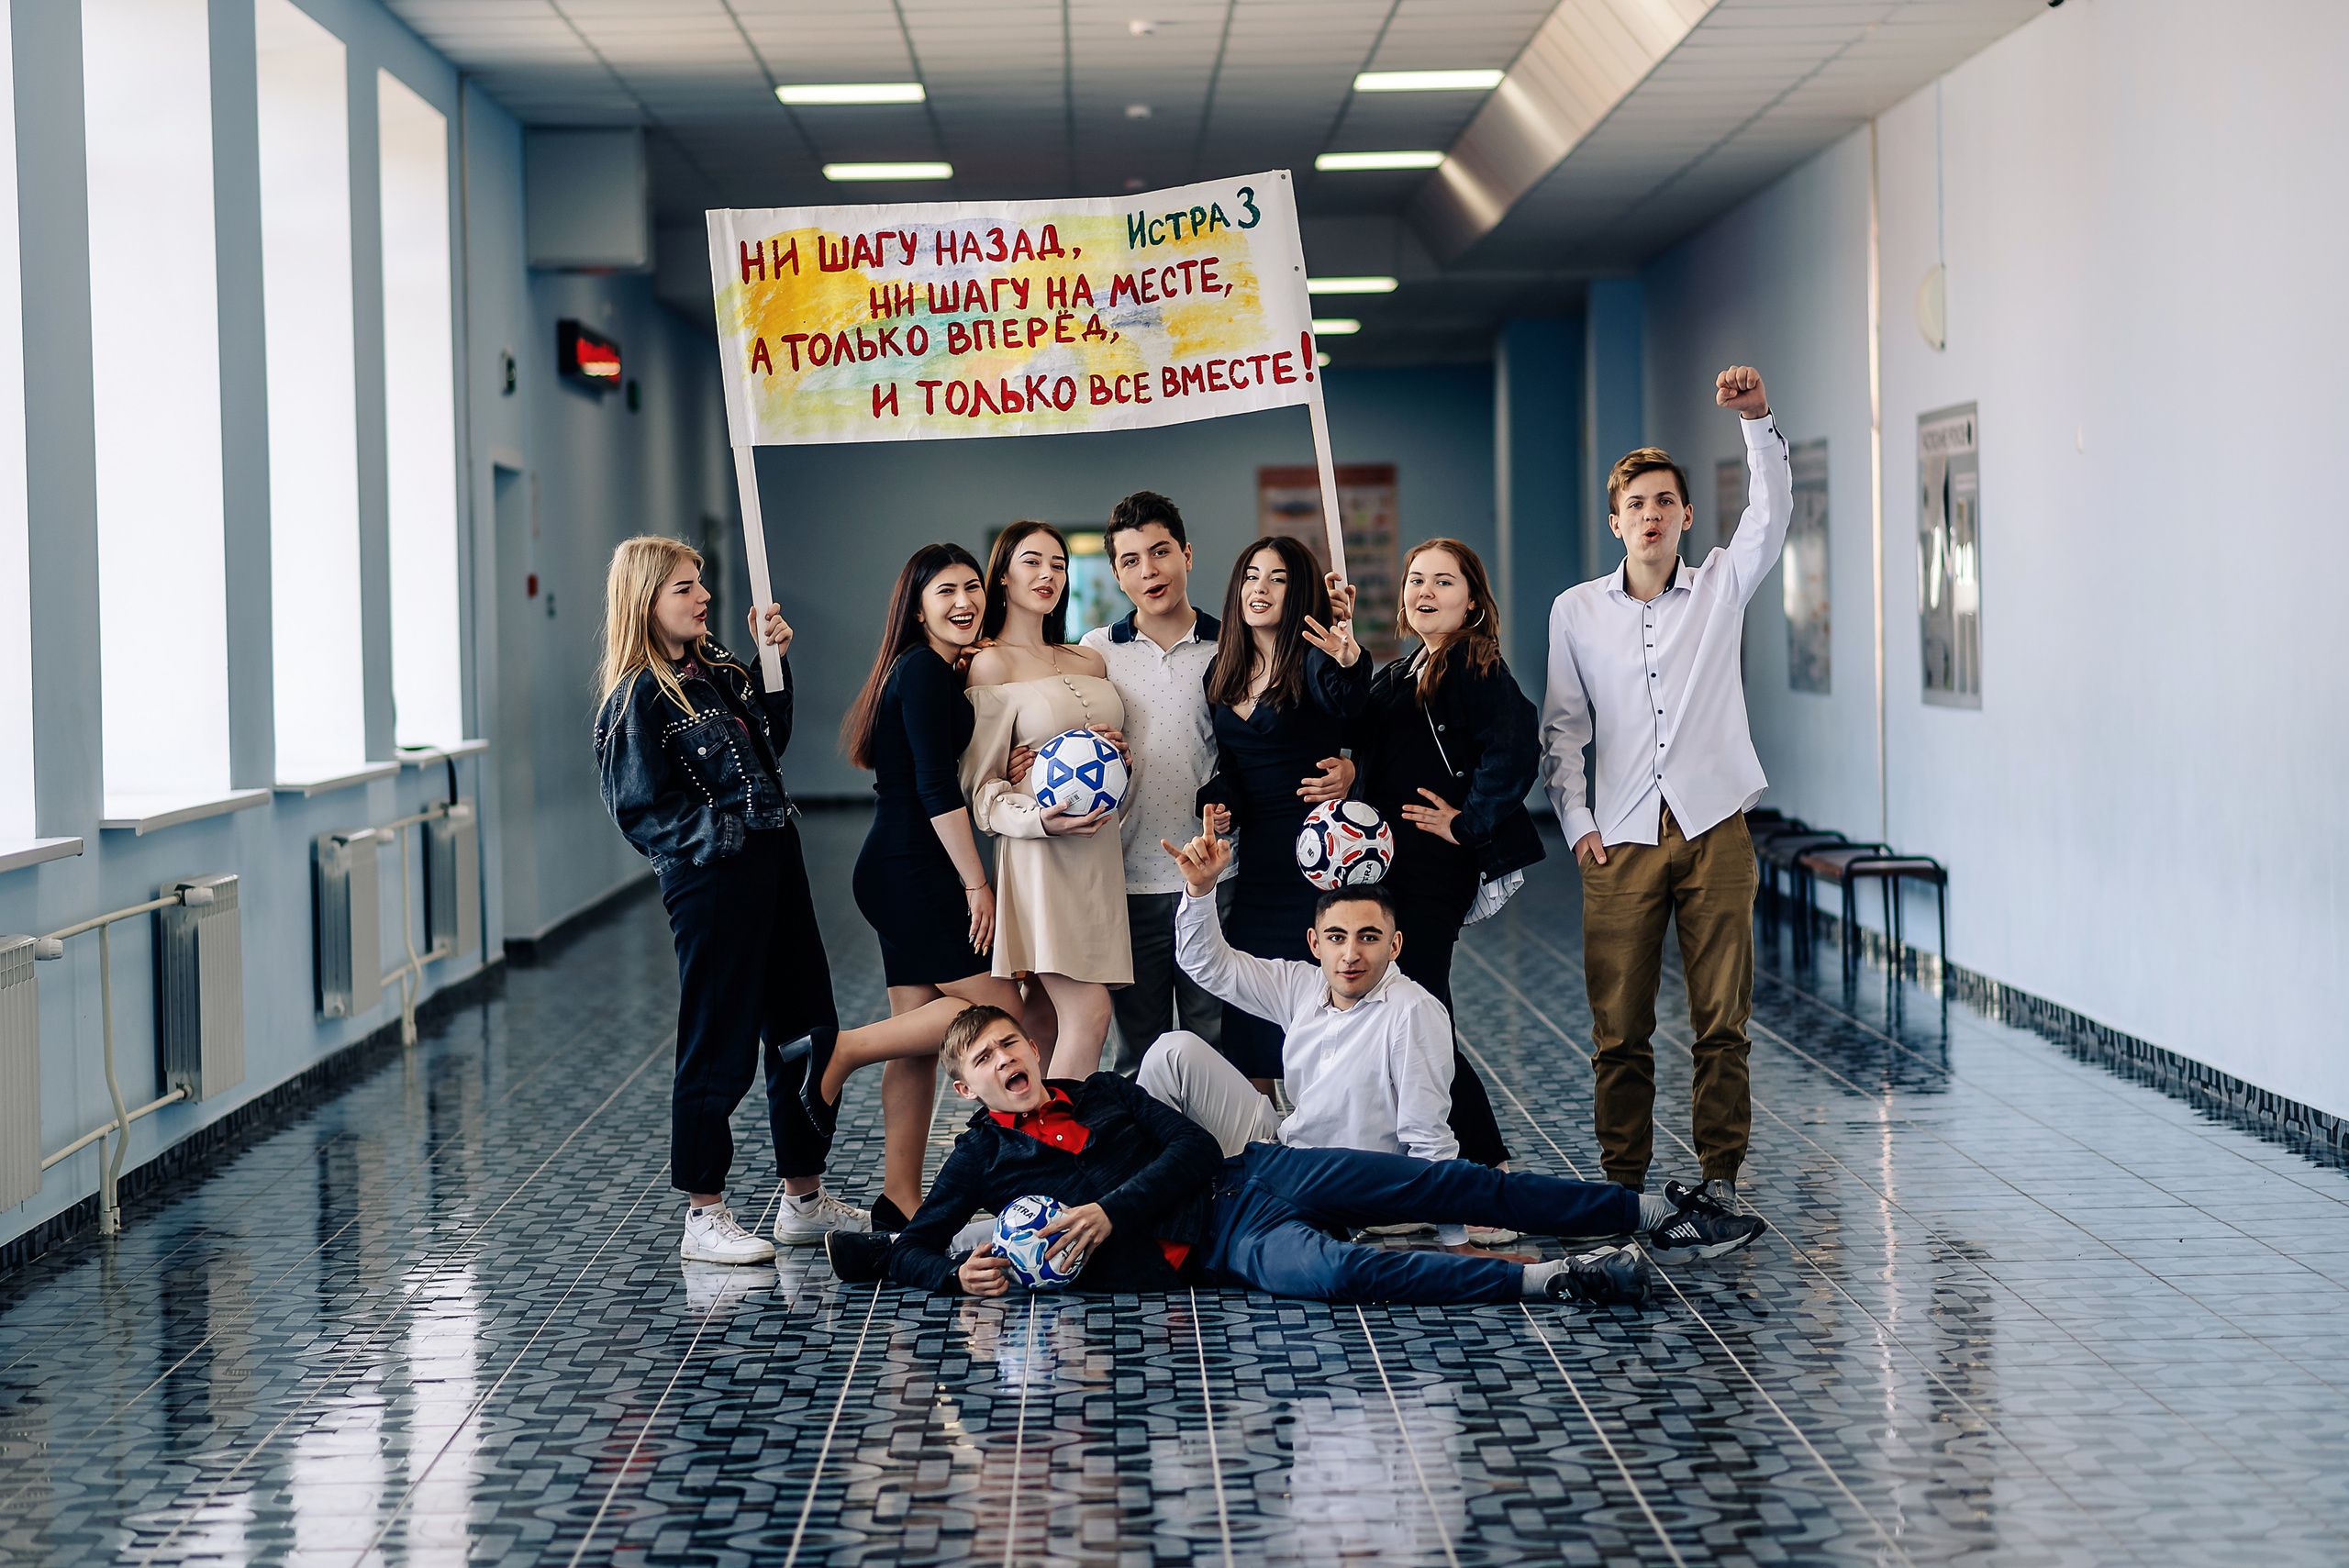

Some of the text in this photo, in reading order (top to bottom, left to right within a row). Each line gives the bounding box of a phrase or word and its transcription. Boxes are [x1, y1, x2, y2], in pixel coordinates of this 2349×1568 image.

[1237, 186, 1262, 230] 3
[740, 224, 1082, 284] НИ ШАГУ НАЗАД,
[868, 256, 1233, 320] НИ ШАГУ НА МЕСТЕ,
[751, 307, 1119, 376] А ТОЛЬКО ВПЕРЁД,
[872, 330, 1314, 419] И ТОЛЬКО ВСЕ ВМЕСТЕ!
